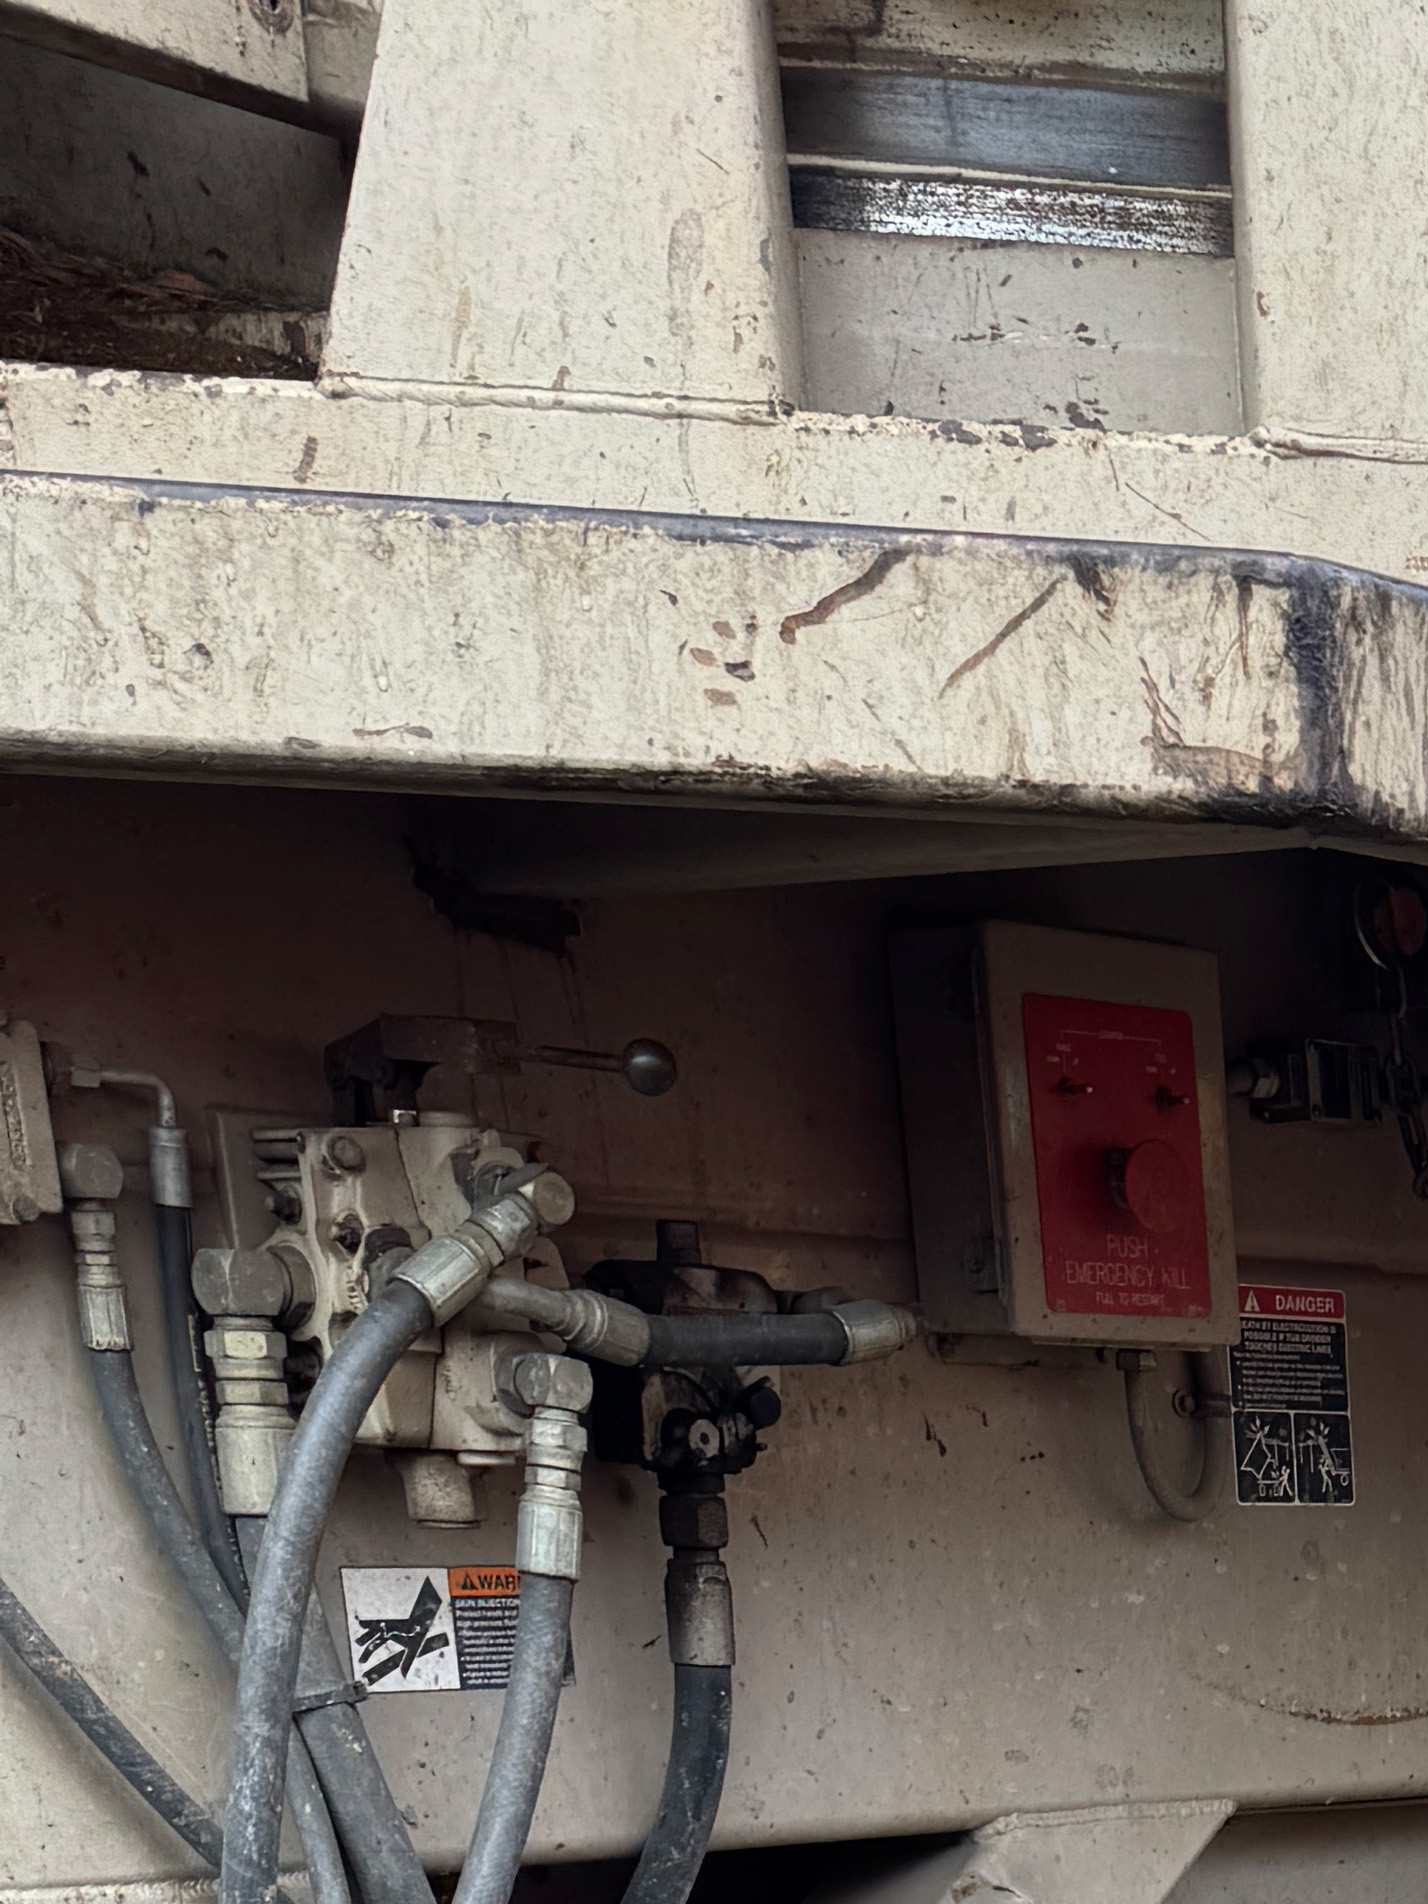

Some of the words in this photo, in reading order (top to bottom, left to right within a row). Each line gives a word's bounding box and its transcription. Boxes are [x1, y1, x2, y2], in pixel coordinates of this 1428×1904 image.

[1106, 1234, 1148, 1258] PUSH
[1065, 1261, 1155, 1287] EMERGENCY
[1161, 1266, 1190, 1290] KILL
[1275, 1295, 1335, 1313] DANGER
